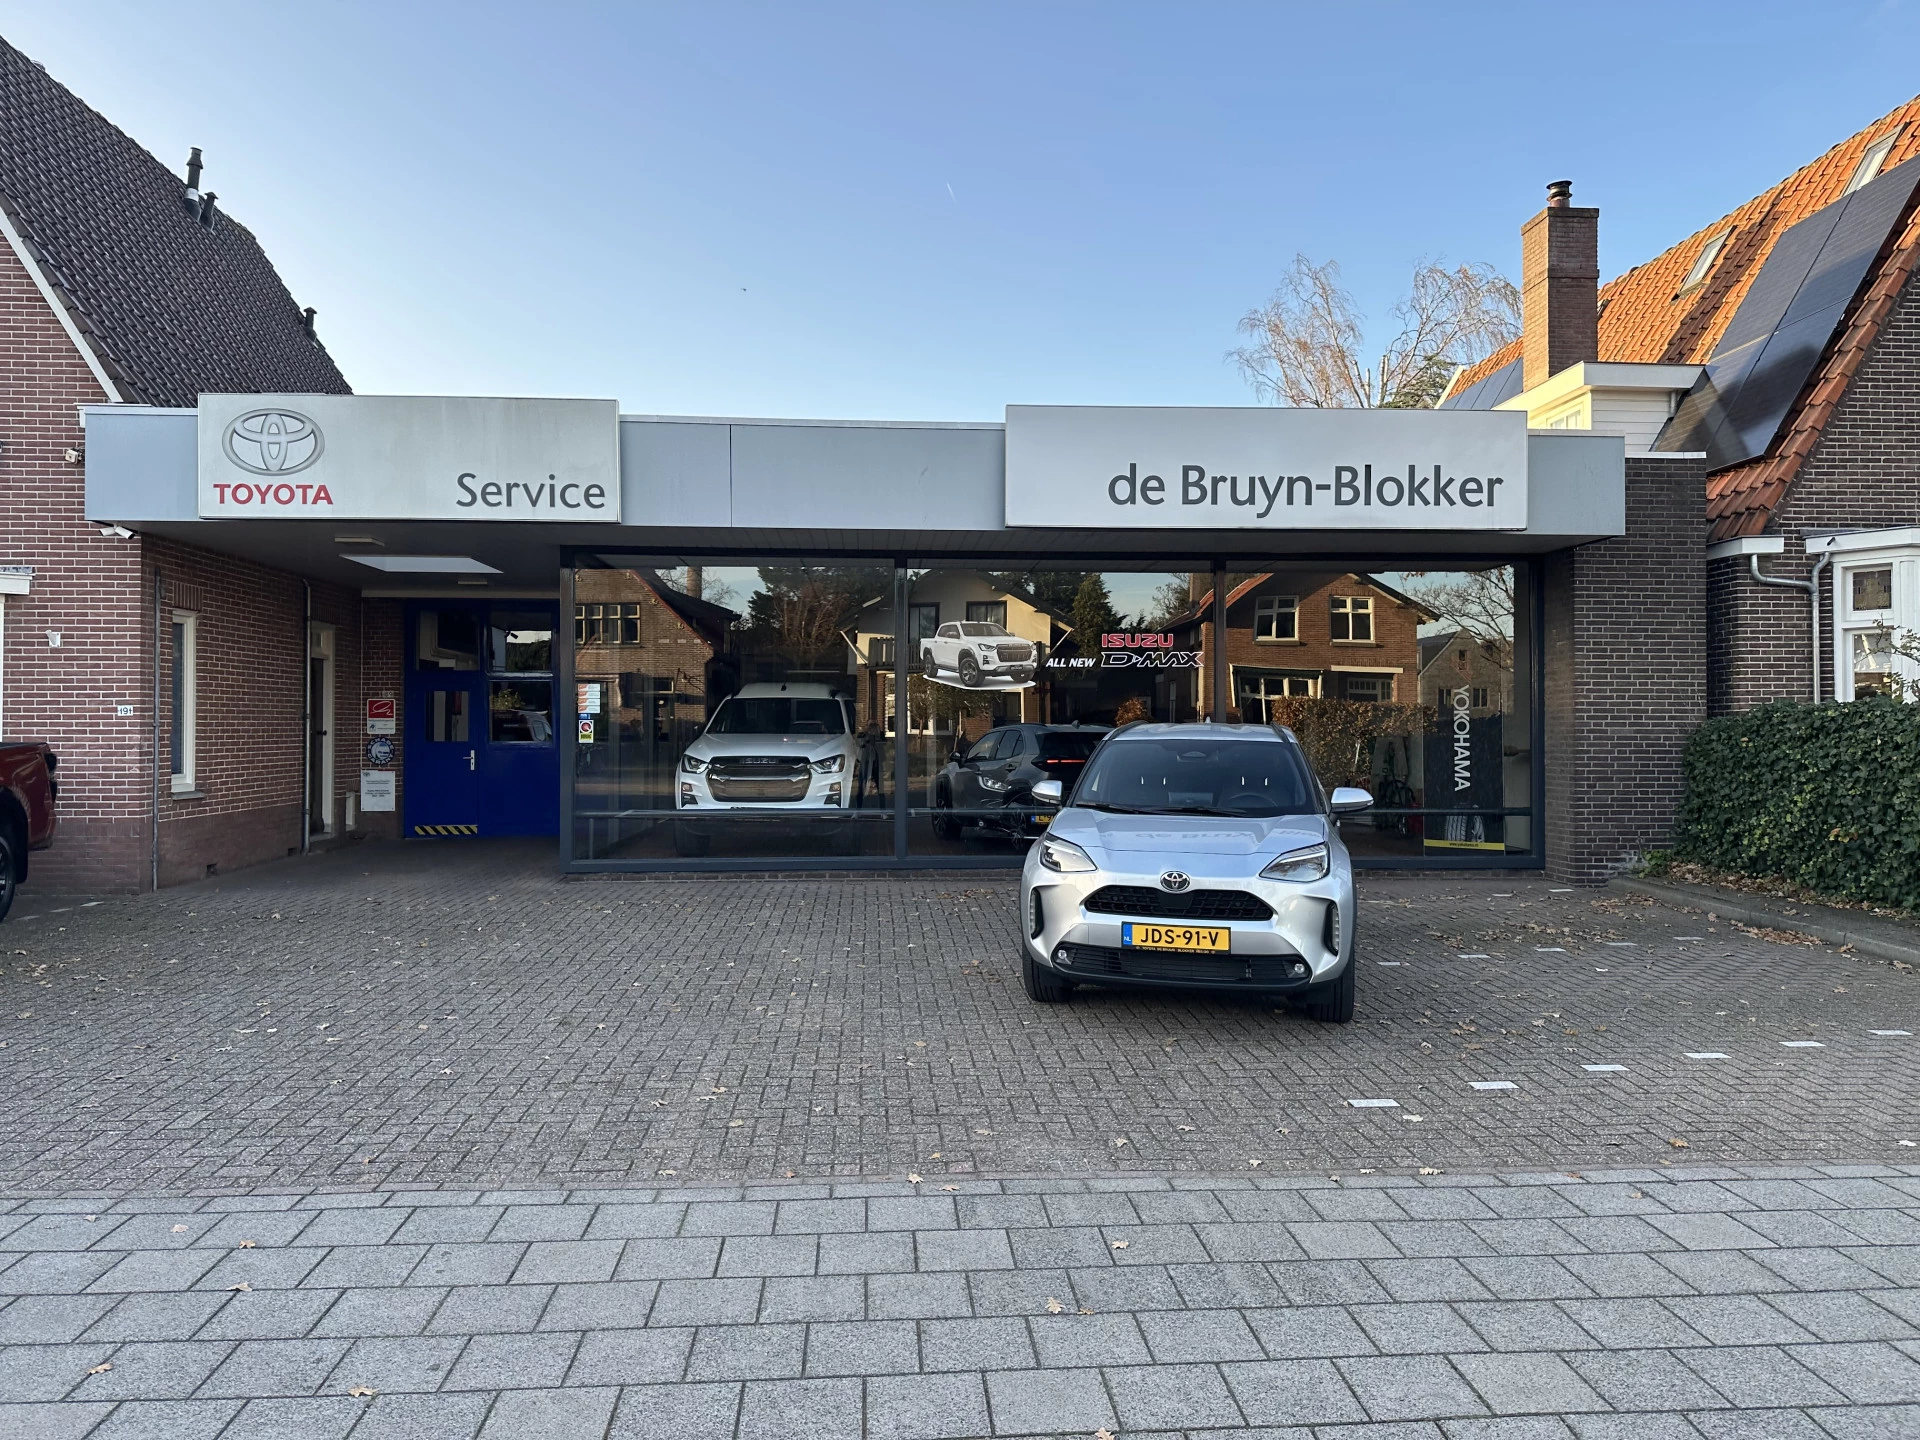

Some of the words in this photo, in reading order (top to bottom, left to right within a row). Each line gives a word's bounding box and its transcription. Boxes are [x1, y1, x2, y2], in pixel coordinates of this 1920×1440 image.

[213, 483, 333, 505] TOYOTA
[456, 473, 605, 509] Service
[1108, 463, 1165, 507] de
[1181, 464, 1503, 518] Bruyn-Blokker
[1101, 633, 1174, 648] ISUZU
[1046, 657, 1066, 668] ALL
[1068, 657, 1096, 668] NEW
[1453, 684, 1471, 792] YOKOHAMA
[1140, 928, 1219, 947] JDS-91-V
